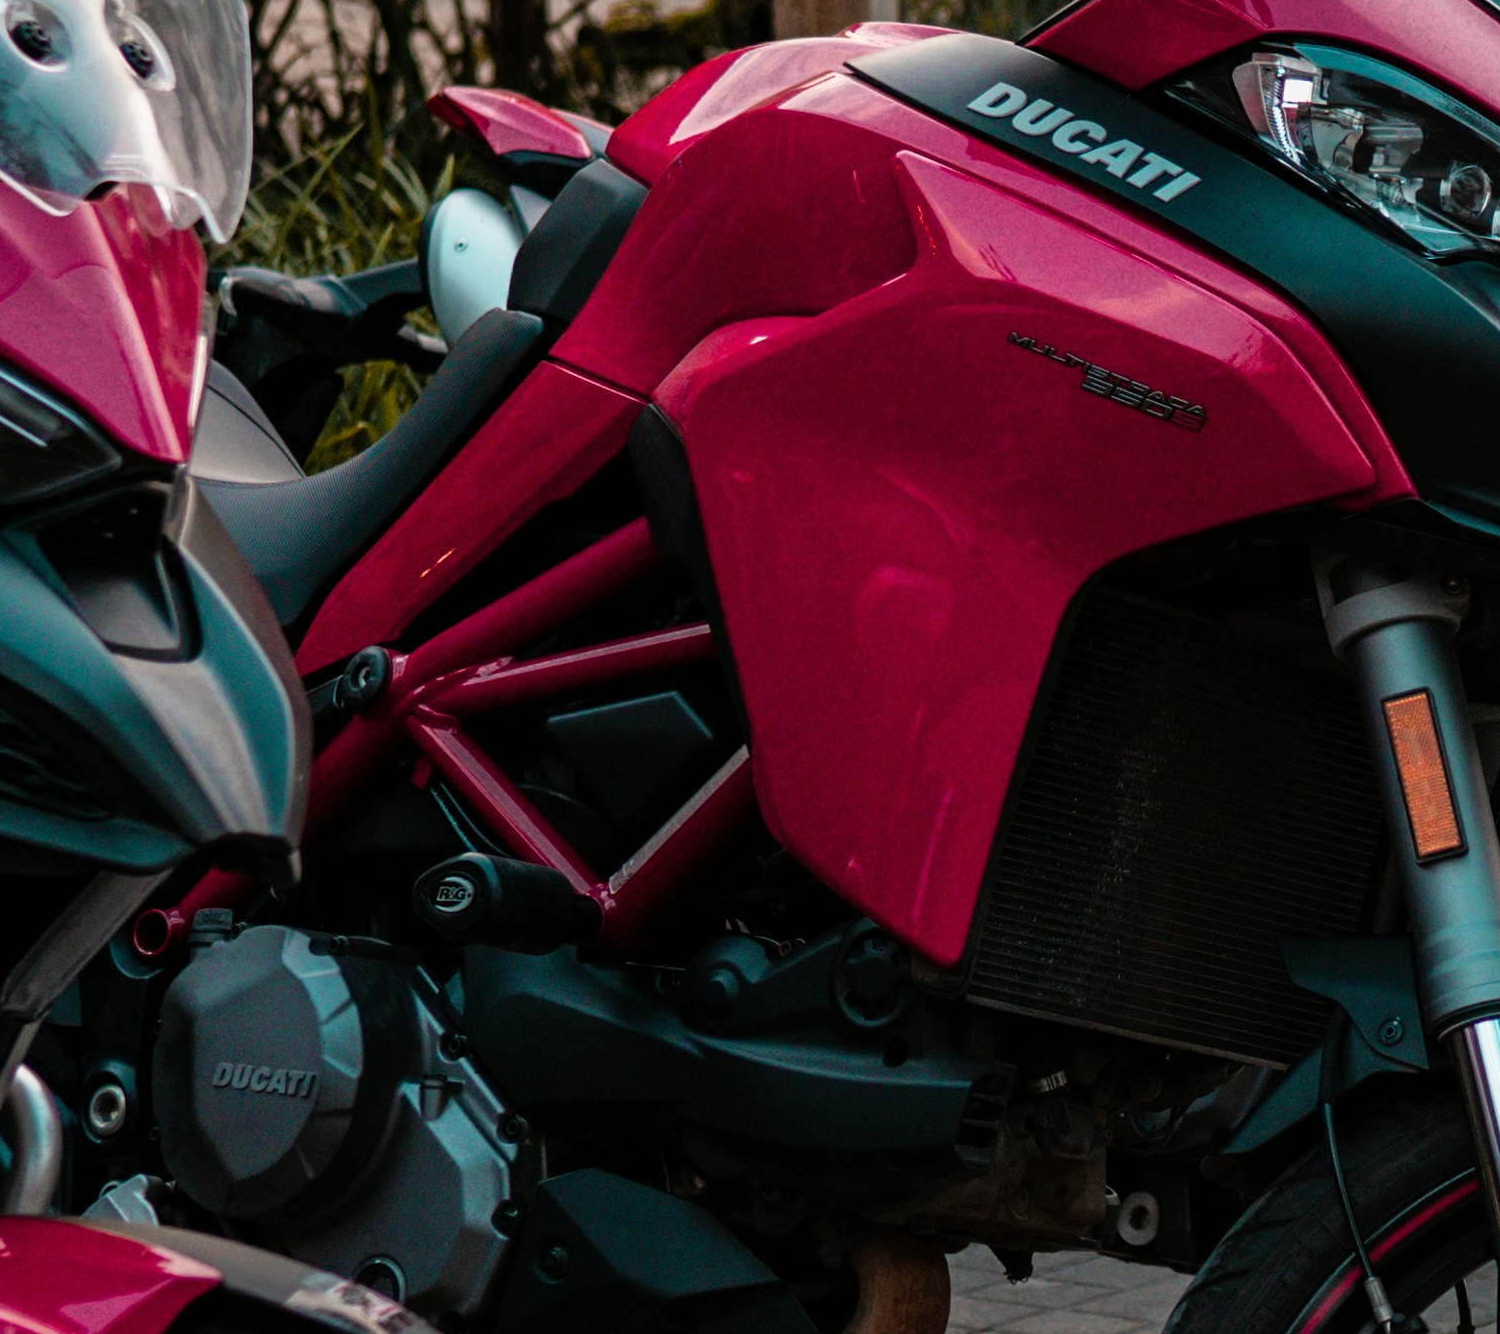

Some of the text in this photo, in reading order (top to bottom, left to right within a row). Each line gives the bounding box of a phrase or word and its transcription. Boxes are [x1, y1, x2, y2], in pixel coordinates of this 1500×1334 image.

[967, 82, 1202, 203] DUCATI
[1008, 332, 1206, 417] MULTISTRADA
[438, 886, 468, 901] R&G
[212, 1062, 317, 1100] DUCATI
